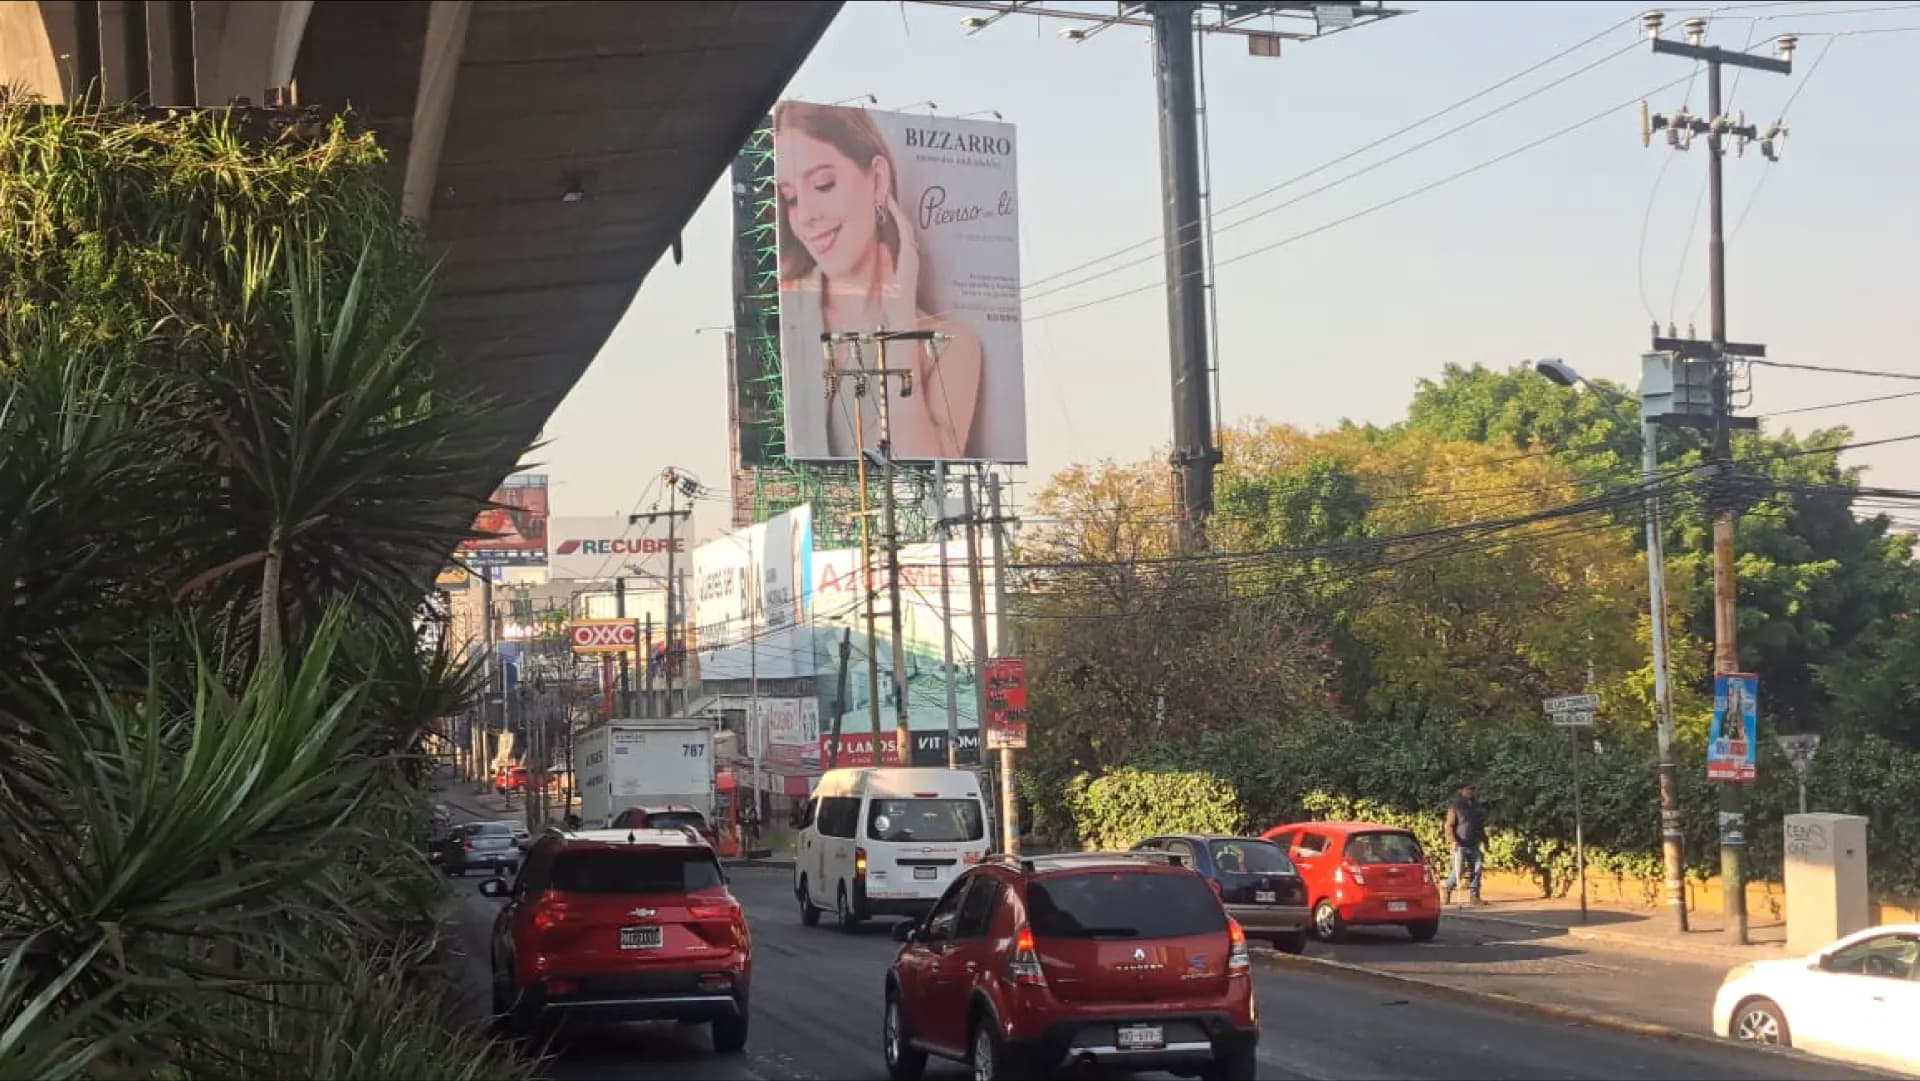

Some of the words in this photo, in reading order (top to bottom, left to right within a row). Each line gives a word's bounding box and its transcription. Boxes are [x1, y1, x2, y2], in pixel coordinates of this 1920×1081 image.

[905, 127, 1011, 156] BIZZARRO
[918, 185, 982, 230] Pienso
[582, 538, 685, 554] RECUBRE
